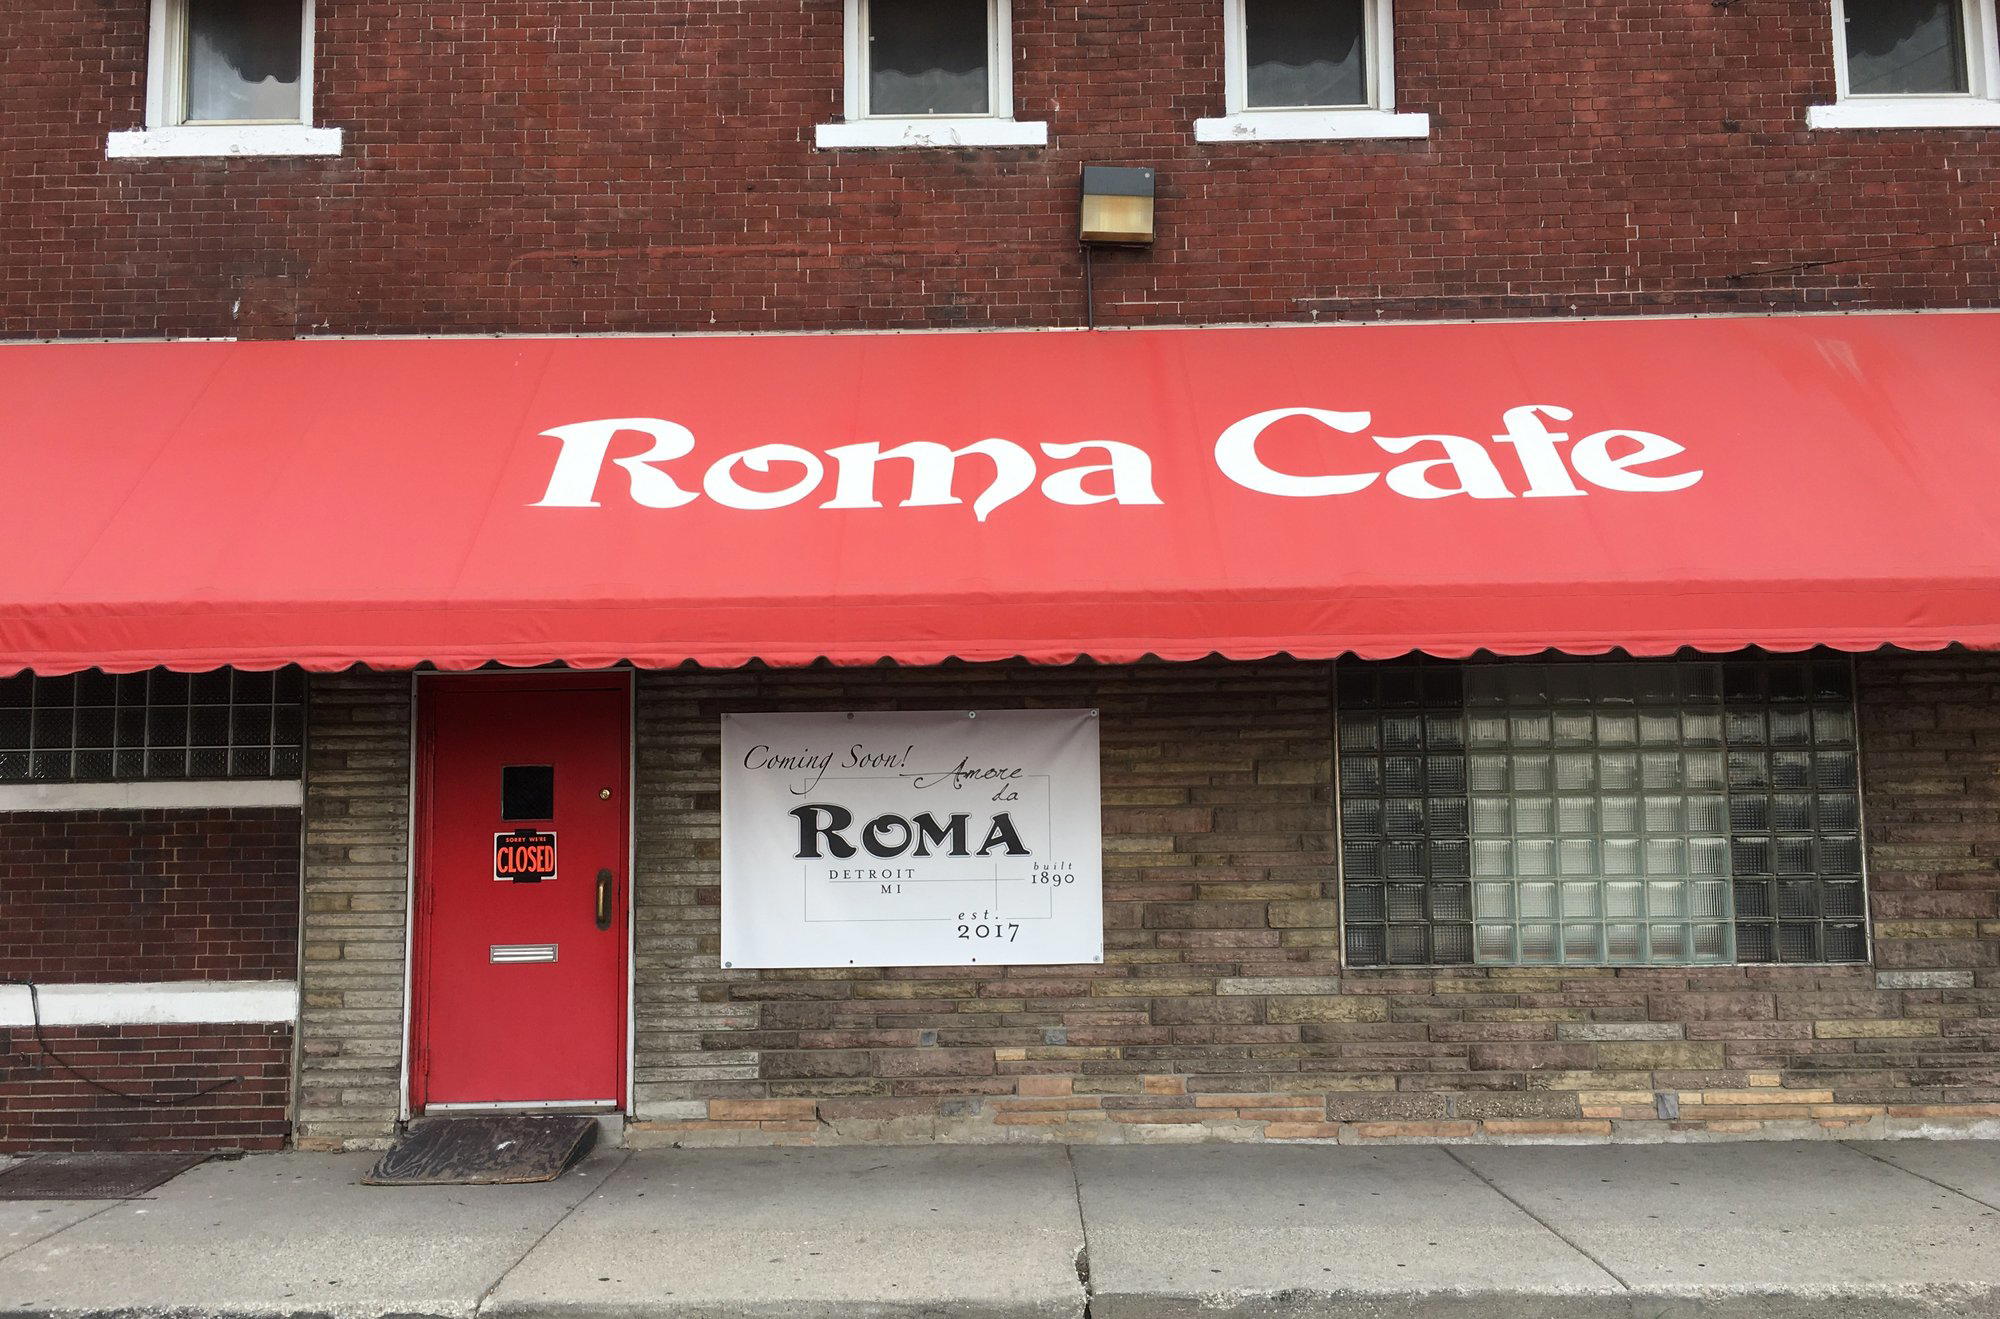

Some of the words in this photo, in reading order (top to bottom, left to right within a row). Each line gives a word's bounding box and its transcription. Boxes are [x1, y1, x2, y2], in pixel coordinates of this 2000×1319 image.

[524, 417, 1165, 522] Roma
[1214, 404, 1703, 499] Cafe
[743, 744, 834, 795] Coming
[841, 743, 914, 768] Soon!
[899, 756, 1023, 789] Amore
[991, 782, 1019, 801] da
[788, 803, 1031, 859] ROMA
[497, 845, 554, 873] CLOSED
[1033, 861, 1073, 871] built
[829, 868, 916, 880] DETROIT
[1031, 873, 1075, 887] 1890
[880, 884, 902, 894] MI
[957, 909, 1000, 920] est.
[957, 922, 1020, 943] 2017
